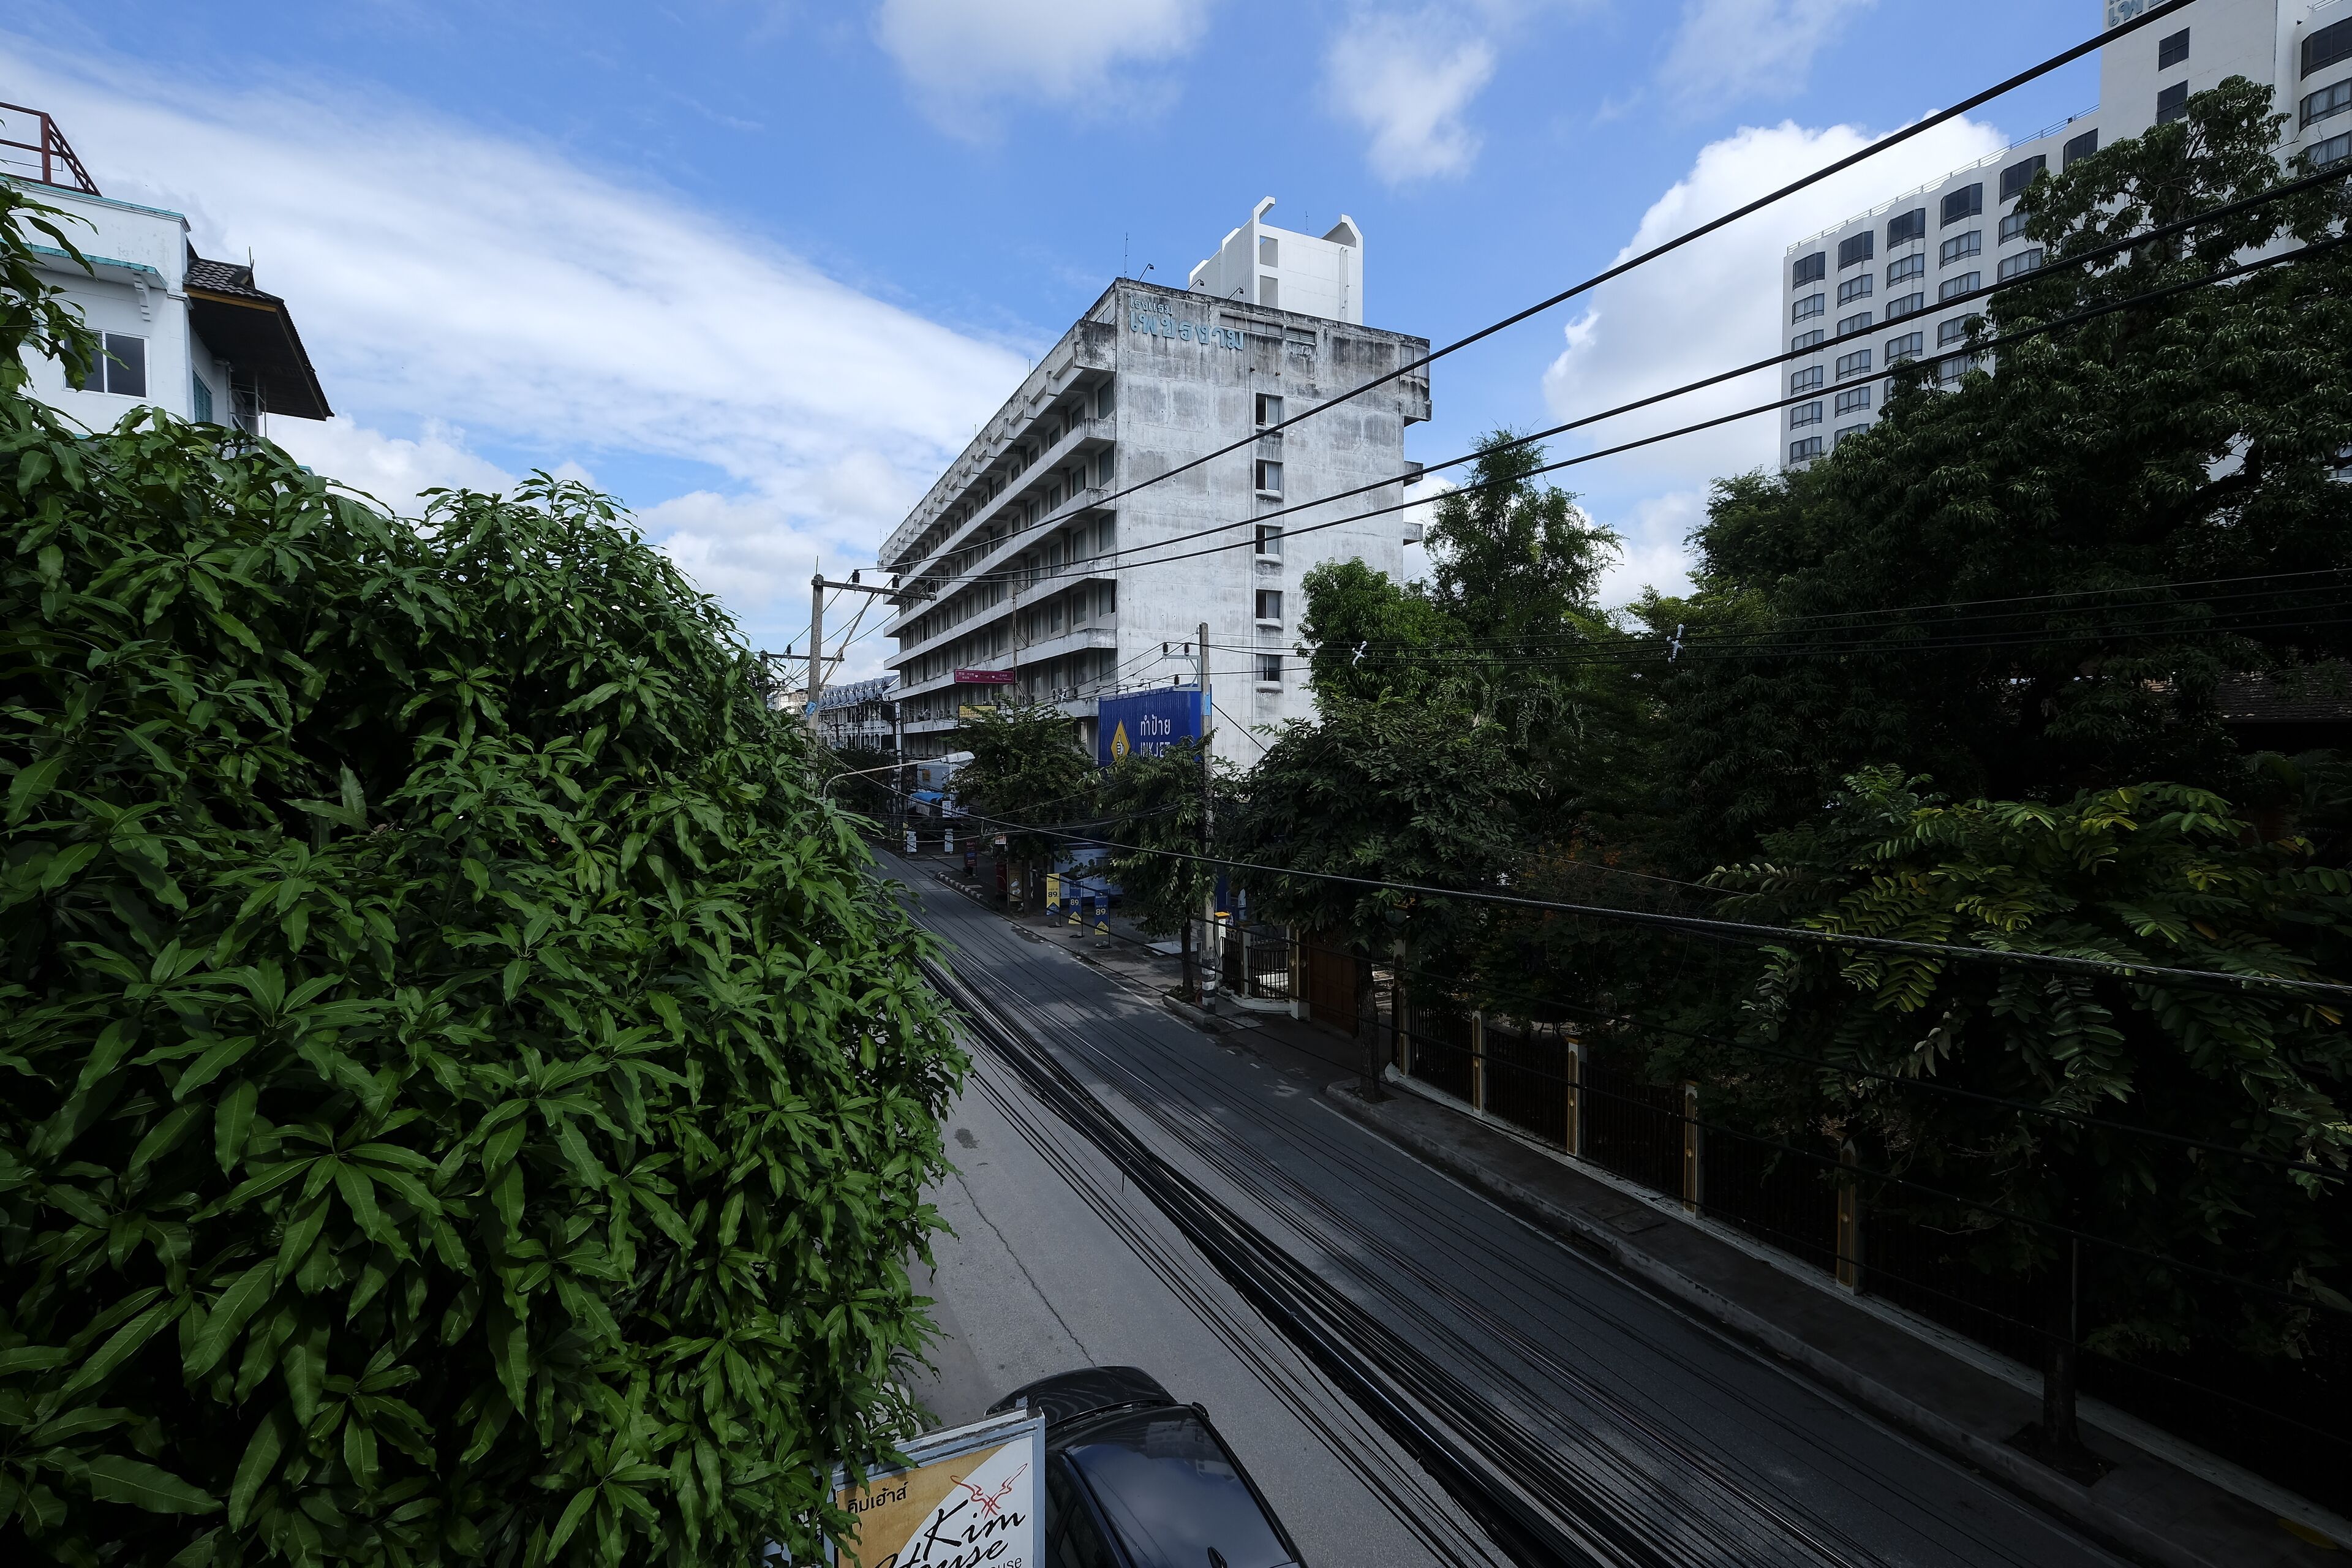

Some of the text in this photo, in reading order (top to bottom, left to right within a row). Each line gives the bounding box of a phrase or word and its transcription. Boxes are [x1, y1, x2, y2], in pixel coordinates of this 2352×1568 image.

[1128, 293, 1173, 315] โรงแรม
[1140, 714, 1170, 736] ทำป้าย
[923, 1499, 1026, 1561] Kim
